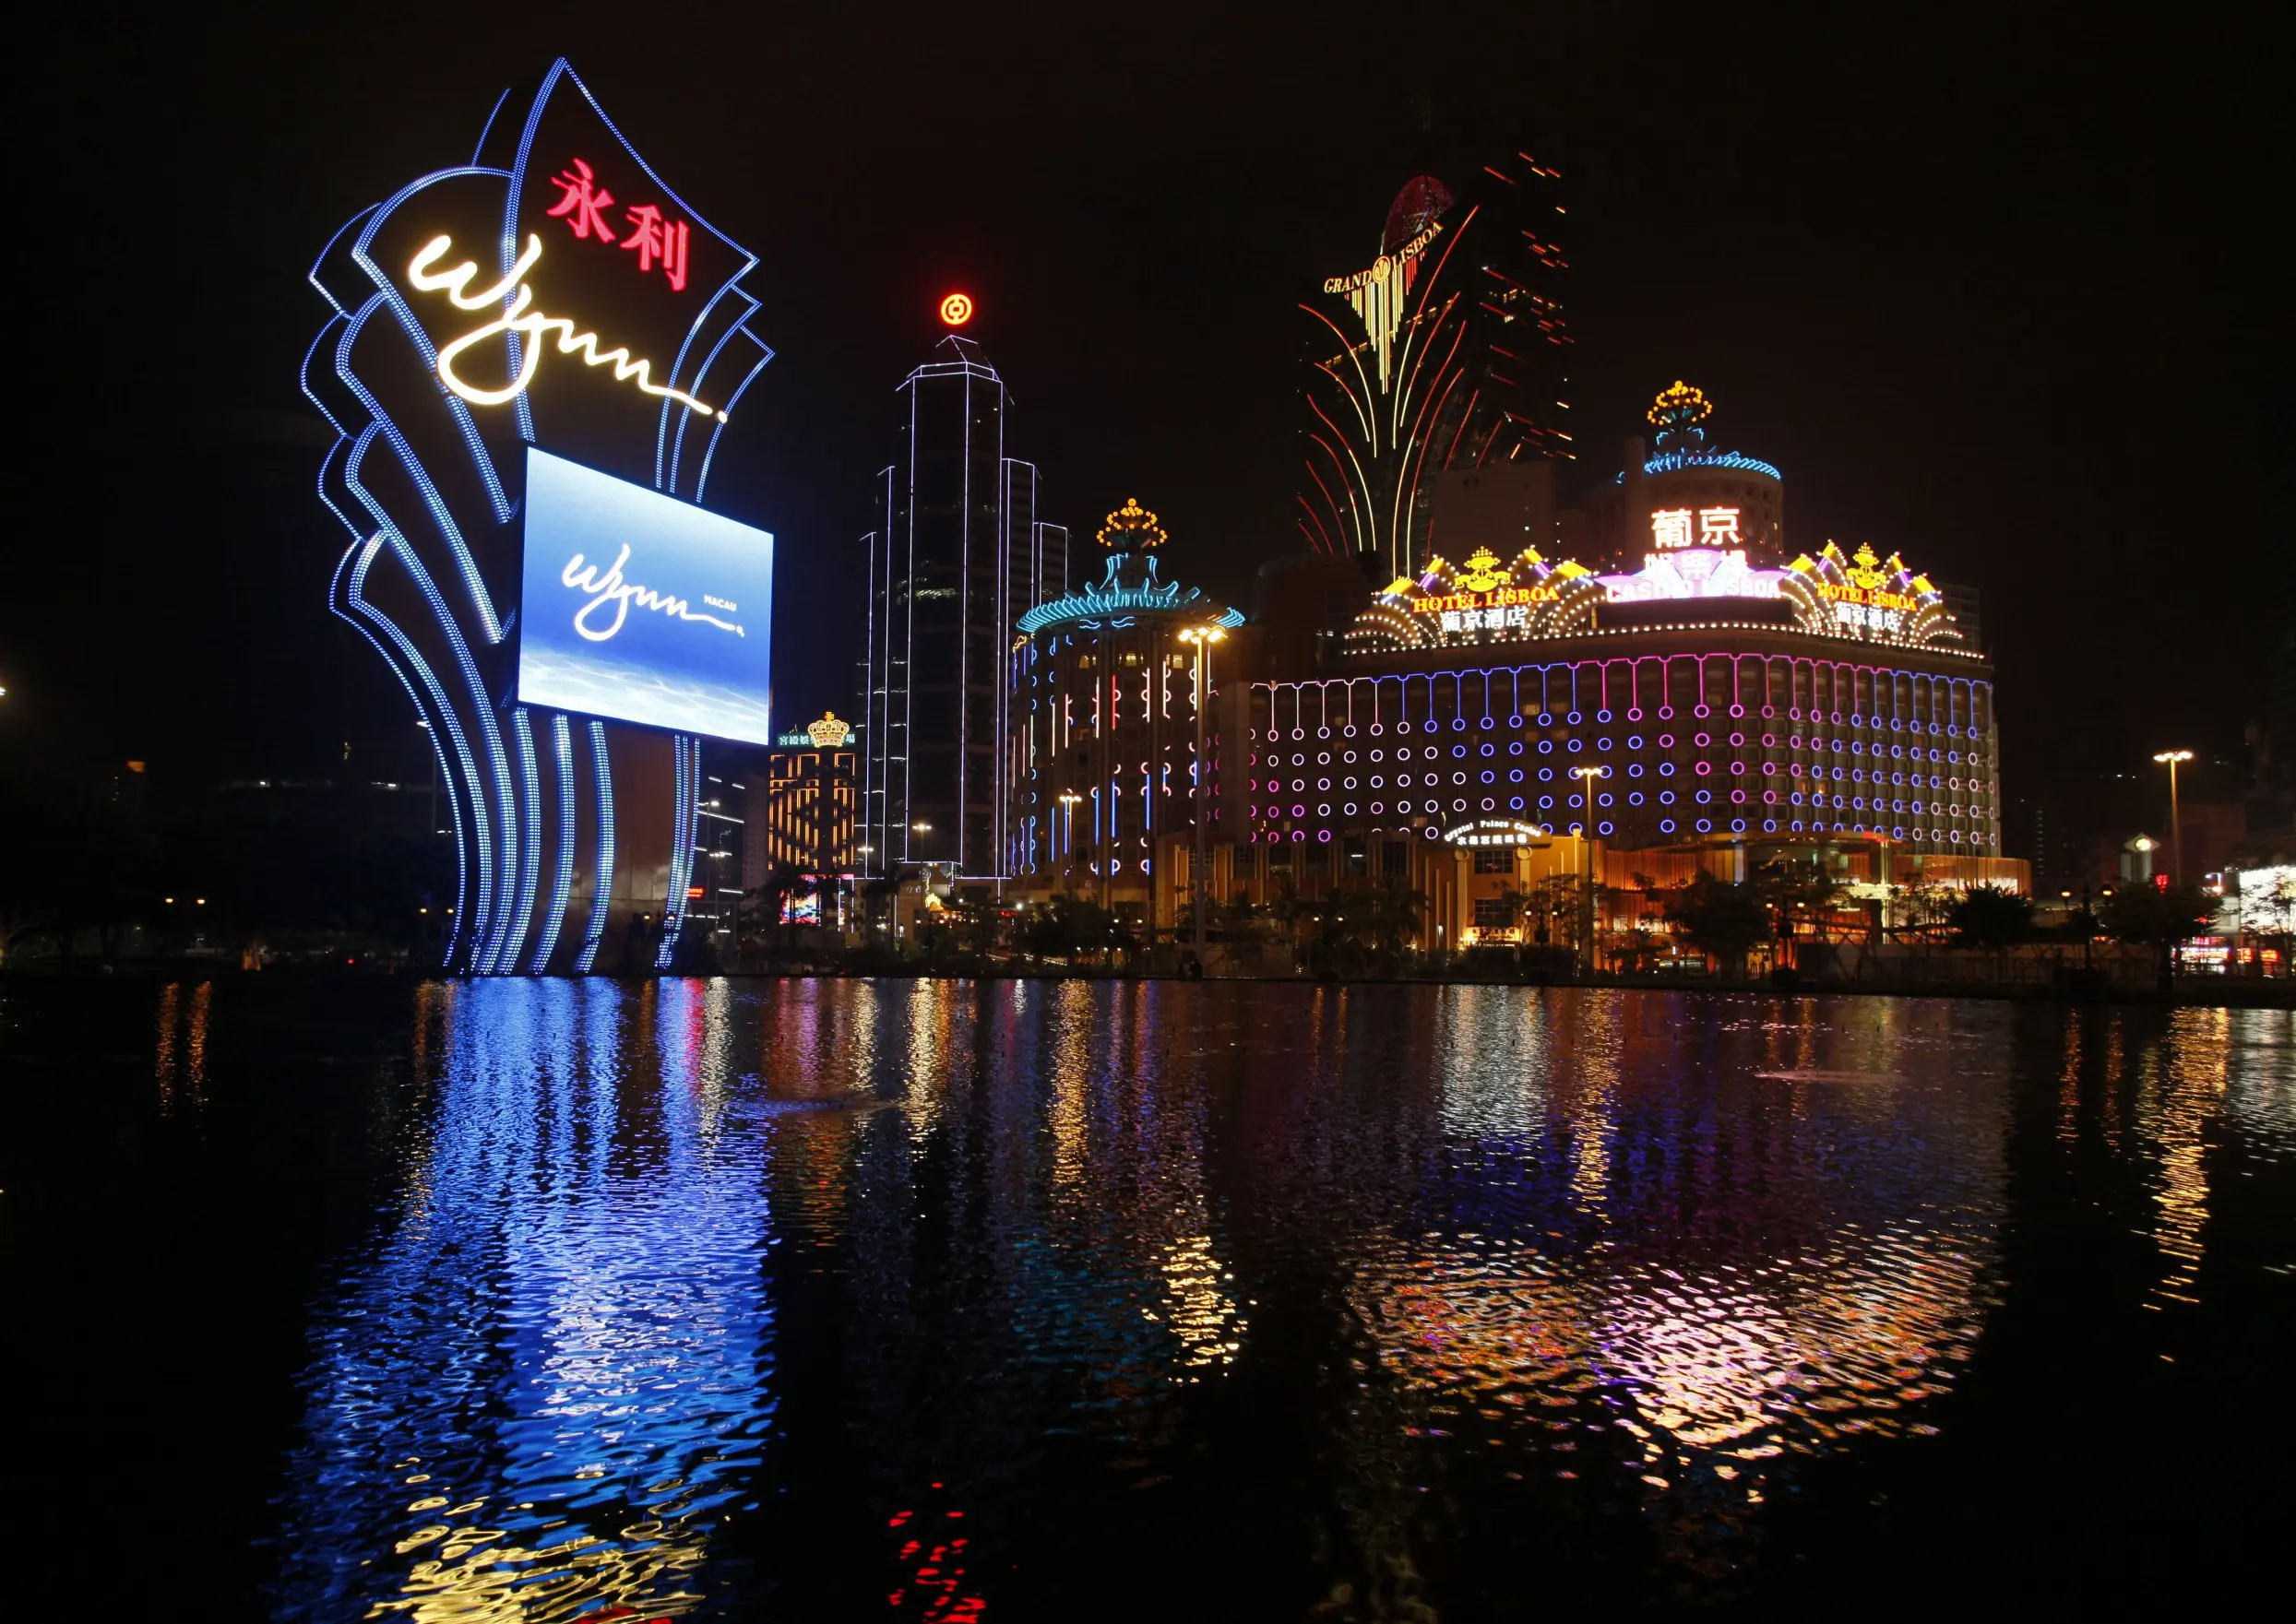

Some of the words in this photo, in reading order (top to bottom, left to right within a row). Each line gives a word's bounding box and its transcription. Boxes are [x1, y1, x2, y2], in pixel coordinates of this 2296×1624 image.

[547, 157, 689, 291] 永利
[1324, 270, 1373, 293] GRAND
[1391, 221, 1444, 269] LISBOA
[1651, 506, 1740, 549] 葡京
[704, 594, 737, 611] MACAU
[1413, 593, 1481, 612] HOTEL
[1485, 587, 1560, 606] LISBOA
[1817, 583, 1867, 603] HOTEL
[1867, 590, 1918, 611] LISBOA
[1442, 605, 1528, 632] 葡京酒店
[1480, 820, 1509, 828] Palace
